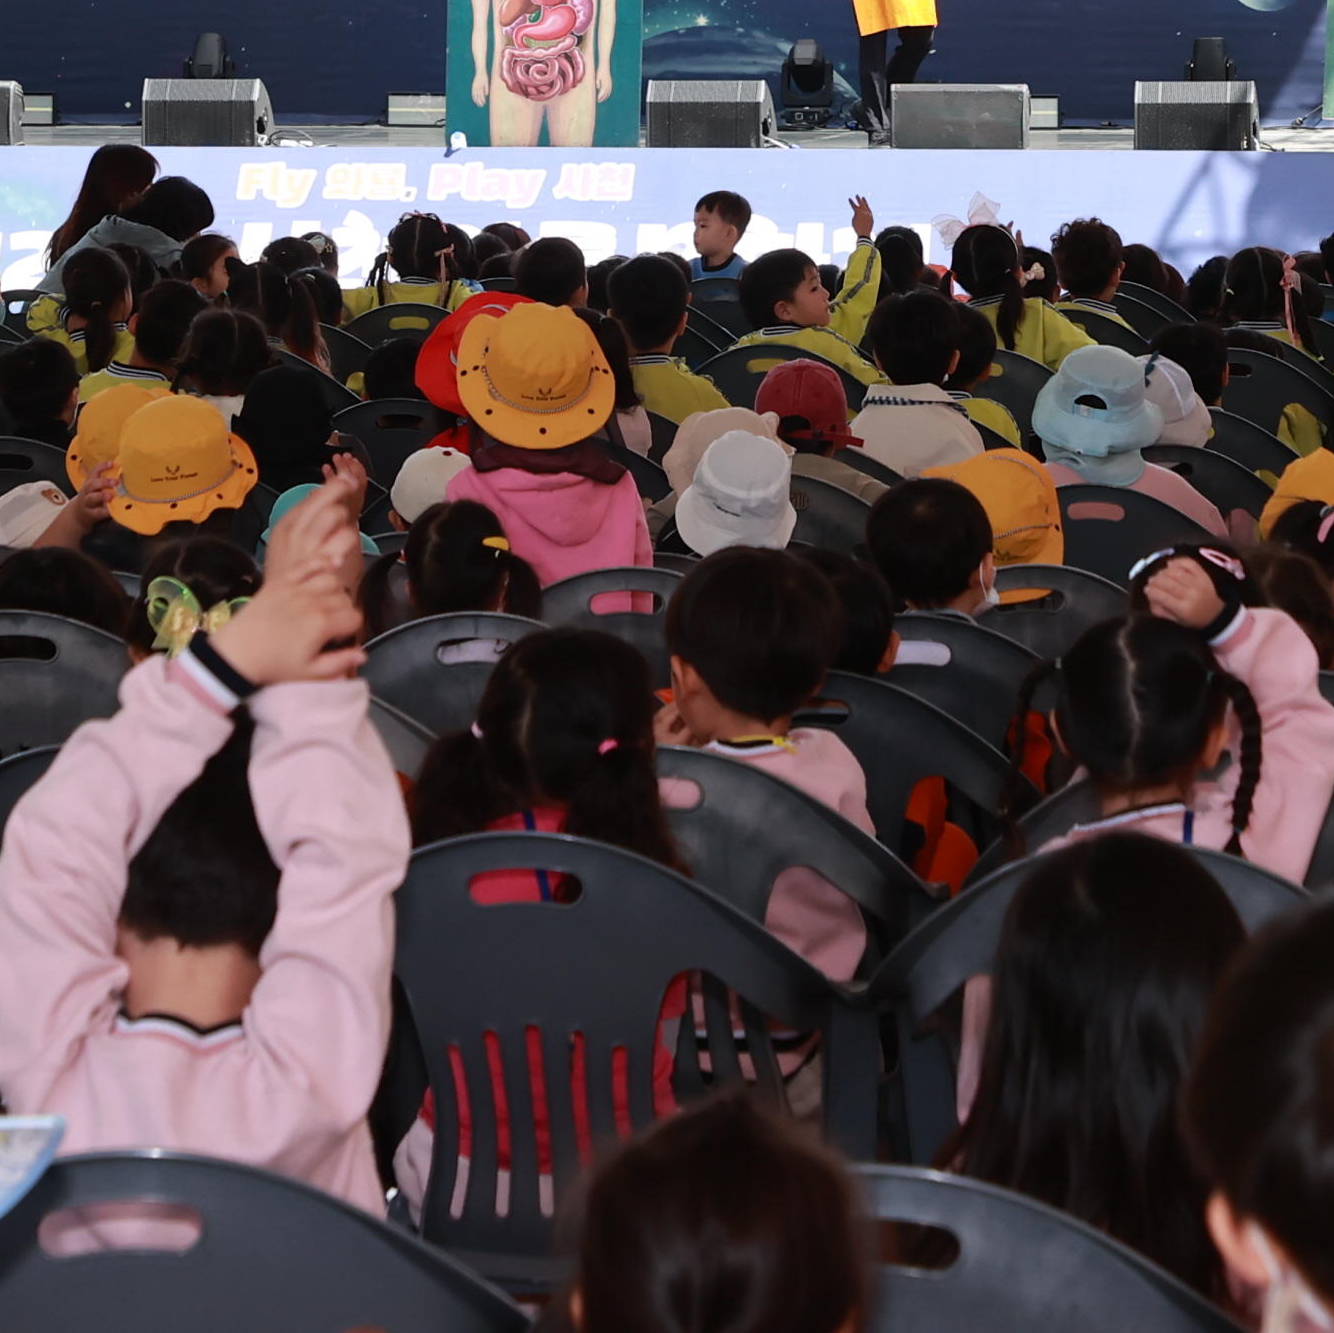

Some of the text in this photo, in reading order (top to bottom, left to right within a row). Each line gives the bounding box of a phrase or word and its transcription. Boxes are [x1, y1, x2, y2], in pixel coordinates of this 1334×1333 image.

[238, 163, 315, 206] Fly
[428, 163, 546, 206] Play
[554, 164, 634, 201] 사천
